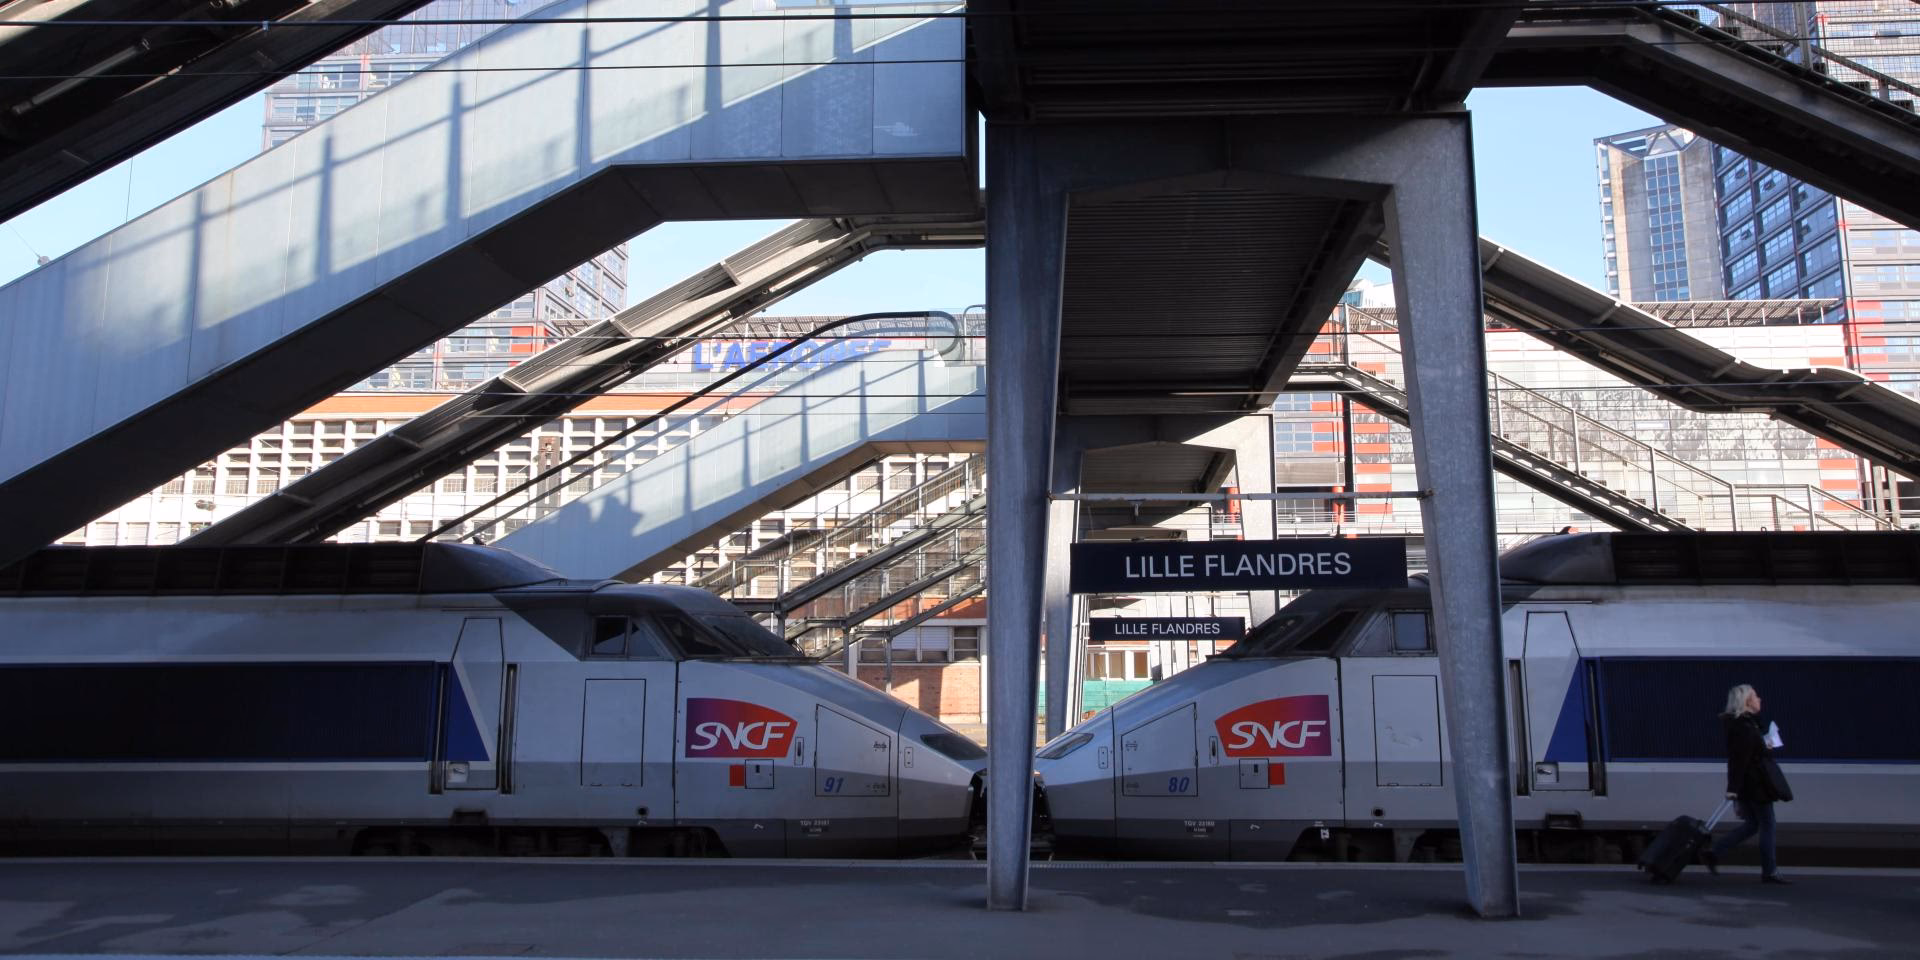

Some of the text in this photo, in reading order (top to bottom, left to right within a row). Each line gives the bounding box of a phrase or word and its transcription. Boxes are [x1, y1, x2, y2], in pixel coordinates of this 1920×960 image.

[1126, 551, 1352, 578] LILLE FLANDRES
[1114, 622, 1221, 635] LILLE FLANDRES
[690, 721, 791, 750] SNCF
[1227, 720, 1327, 749] SNCF
[823, 776, 844, 793] 91
[1168, 776, 1190, 793] 80
